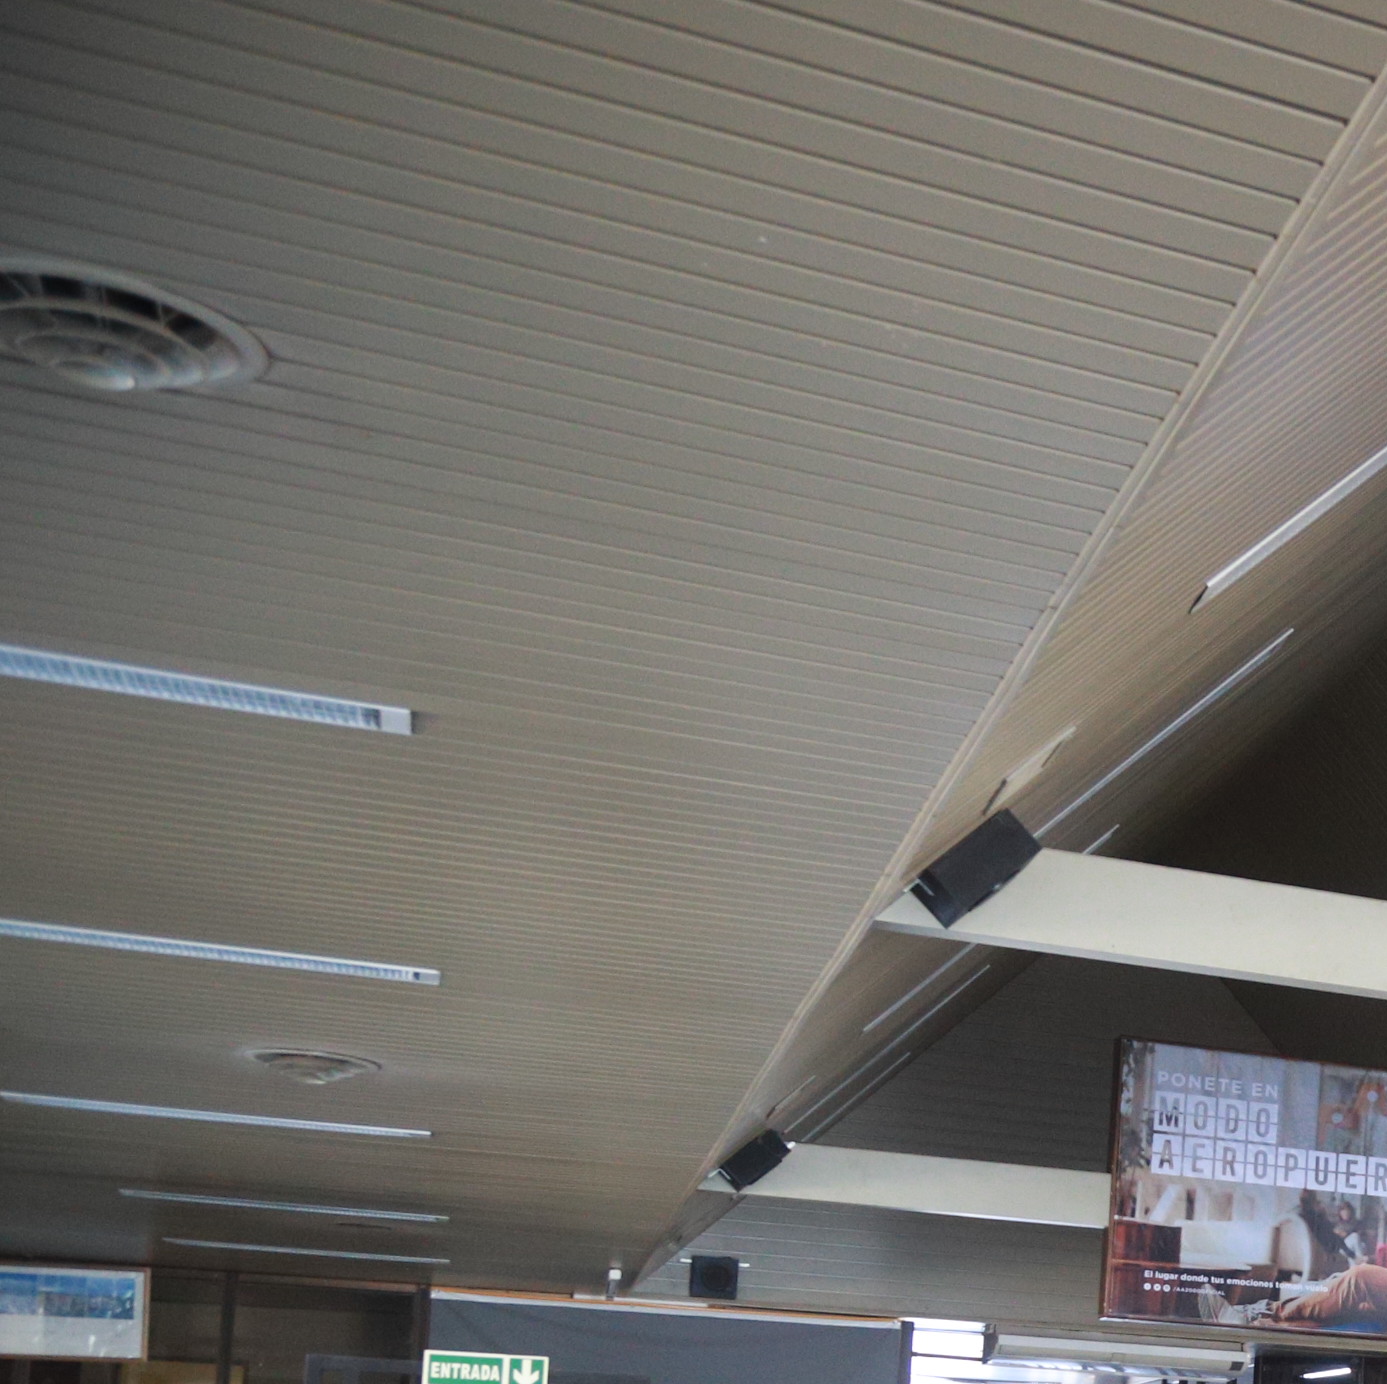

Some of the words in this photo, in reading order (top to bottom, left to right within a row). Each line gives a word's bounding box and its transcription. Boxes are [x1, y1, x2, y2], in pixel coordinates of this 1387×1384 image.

[1157, 1071, 1243, 1095] PONETE
[1251, 1083, 1279, 1099] EN
[1158, 1096, 1271, 1138] MODO
[1144, 1270, 1153, 1279] El
[1155, 1271, 1178, 1282] lugar
[1180, 1273, 1210, 1283] donde
[1211, 1276, 1225, 1285] tus
[1226, 1278, 1274, 1289] emociones
[430, 1361, 500, 1381] ENTRADA
